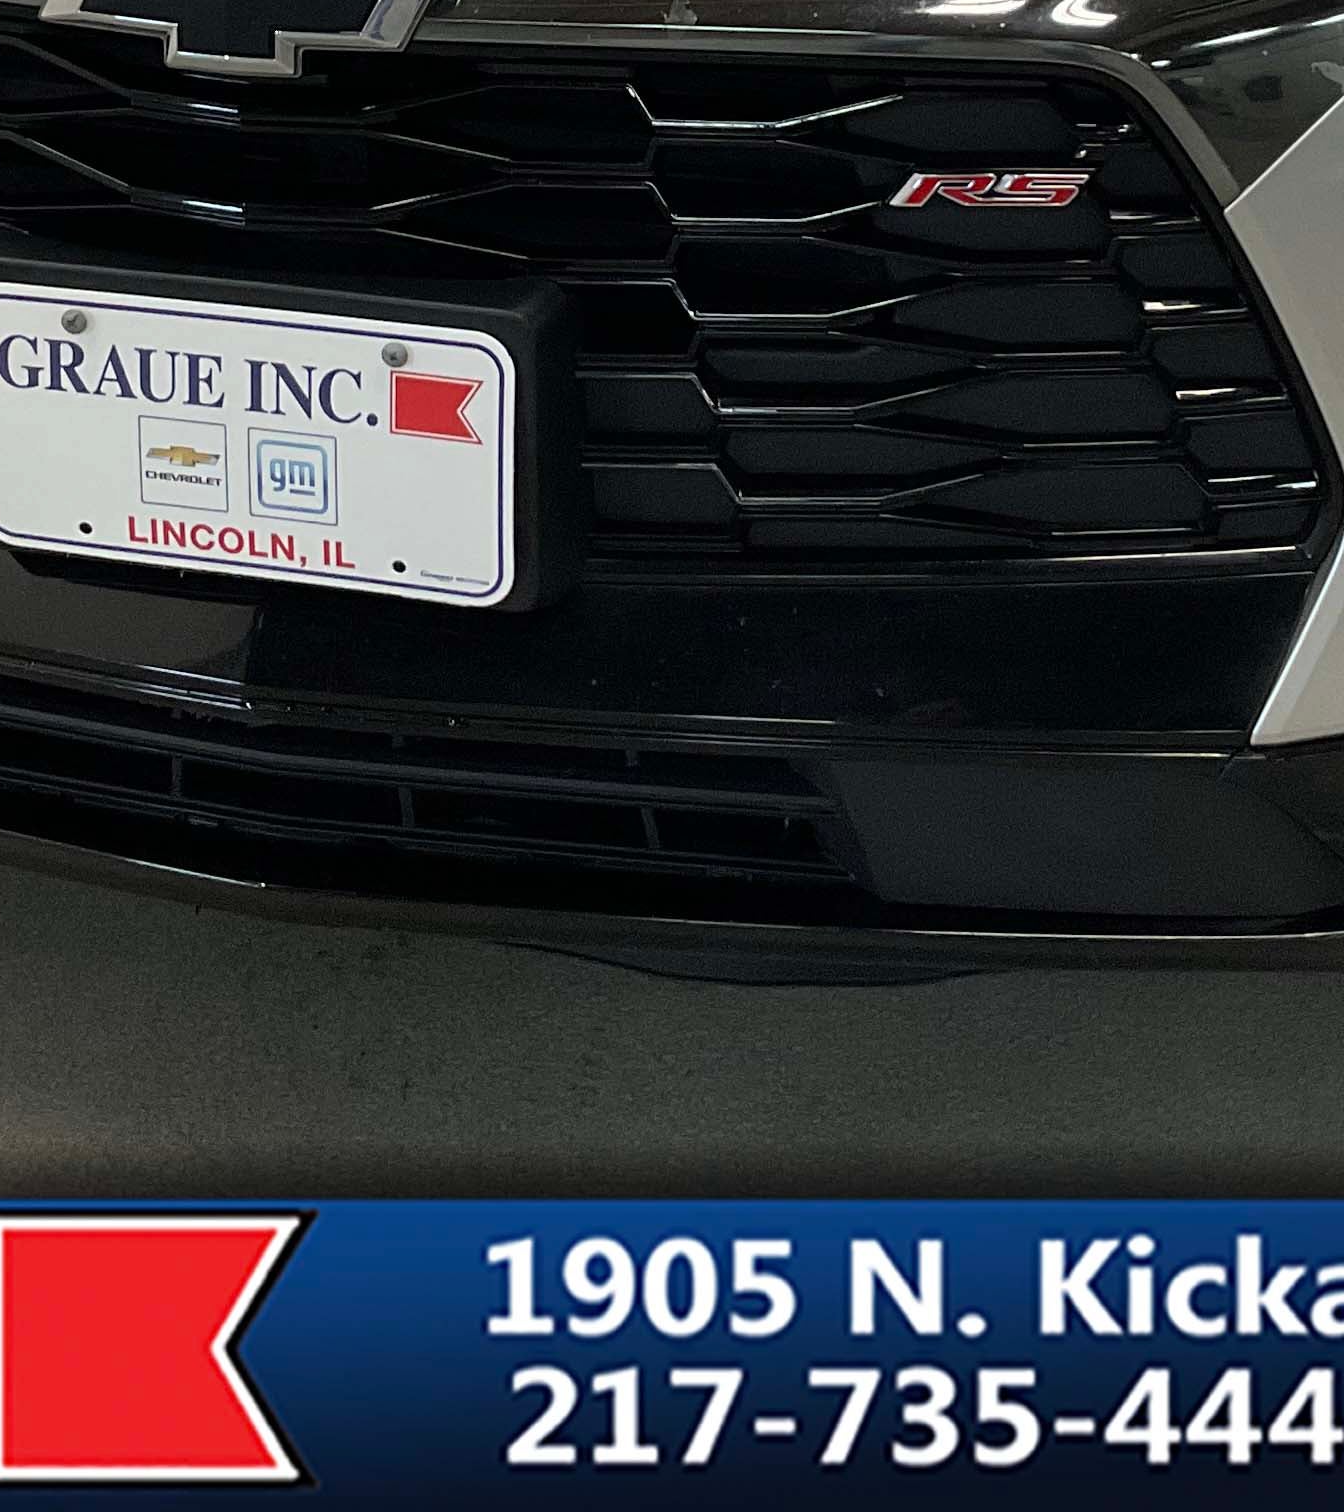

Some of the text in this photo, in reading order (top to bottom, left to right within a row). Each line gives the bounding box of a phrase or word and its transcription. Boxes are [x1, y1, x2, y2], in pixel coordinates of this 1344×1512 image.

[889, 172, 1090, 207] RS
[244, 358, 379, 427] INC.
[145, 469, 223, 487] CHEVROLET
[269, 457, 316, 497] gm
[127, 515, 356, 570] LINCOLN, IL
